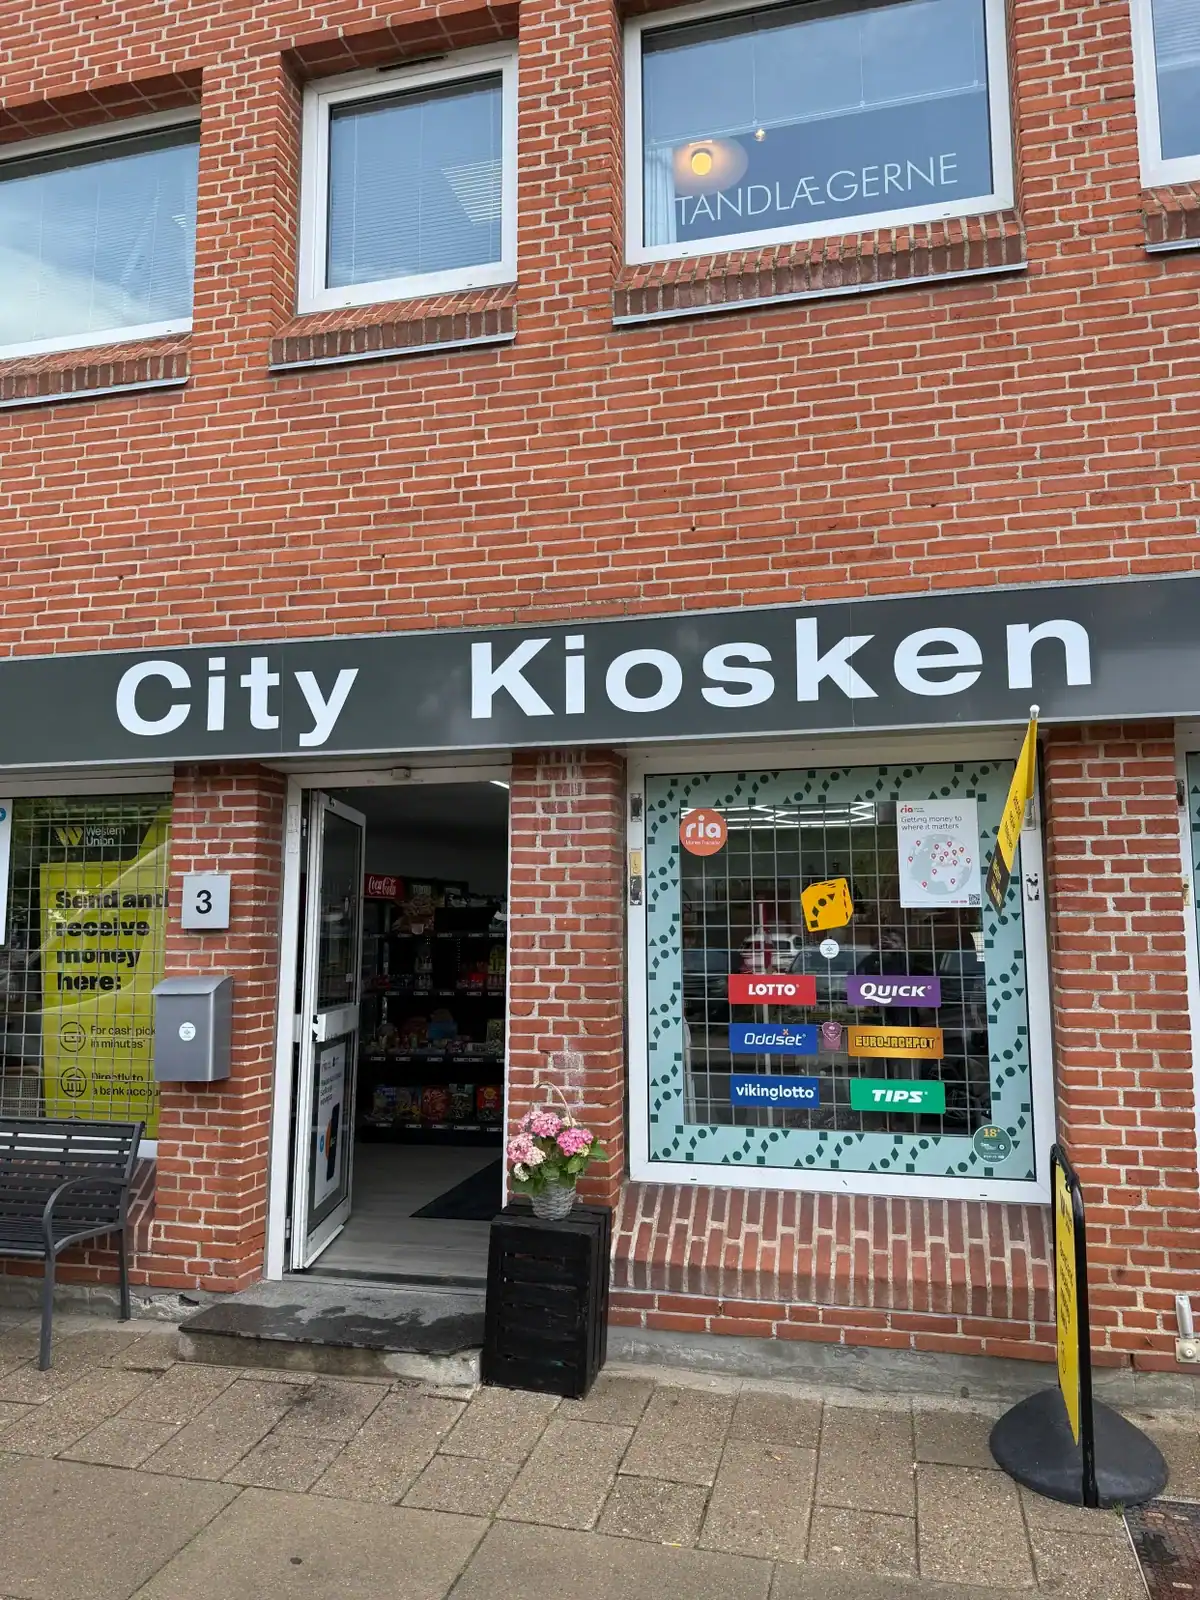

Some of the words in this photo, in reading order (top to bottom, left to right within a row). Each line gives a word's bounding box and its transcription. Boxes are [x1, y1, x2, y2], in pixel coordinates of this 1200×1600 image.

[674, 152, 958, 226] TANDLÆGERNE
[116, 656, 359, 747] City
[470, 617, 1092, 719] Kiosken
[685, 815, 721, 838] ria
[901, 816, 928, 824] Getting
[86, 824, 125, 836] Western
[86, 836, 114, 846] Union
[56, 890, 119, 909] Send
[123, 889, 168, 908] and
[195, 889, 212, 914] 3
[56, 918, 150, 936] receive
[57, 949, 140, 967] money
[58, 972, 121, 990] here:
[91, 1025, 107, 1035] For
[108, 1026, 131, 1035] cash
[91, 1040, 99, 1048] in
[744, 1032, 804, 1046] Oddset
[855, 1036, 935, 1049] EUROJACKPOT
[132, 1073, 144, 1081] to
[99, 1087, 124, 1096] bank
[735, 1084, 814, 1100] vikinglotto
[872, 1089, 923, 1103] TIPS
